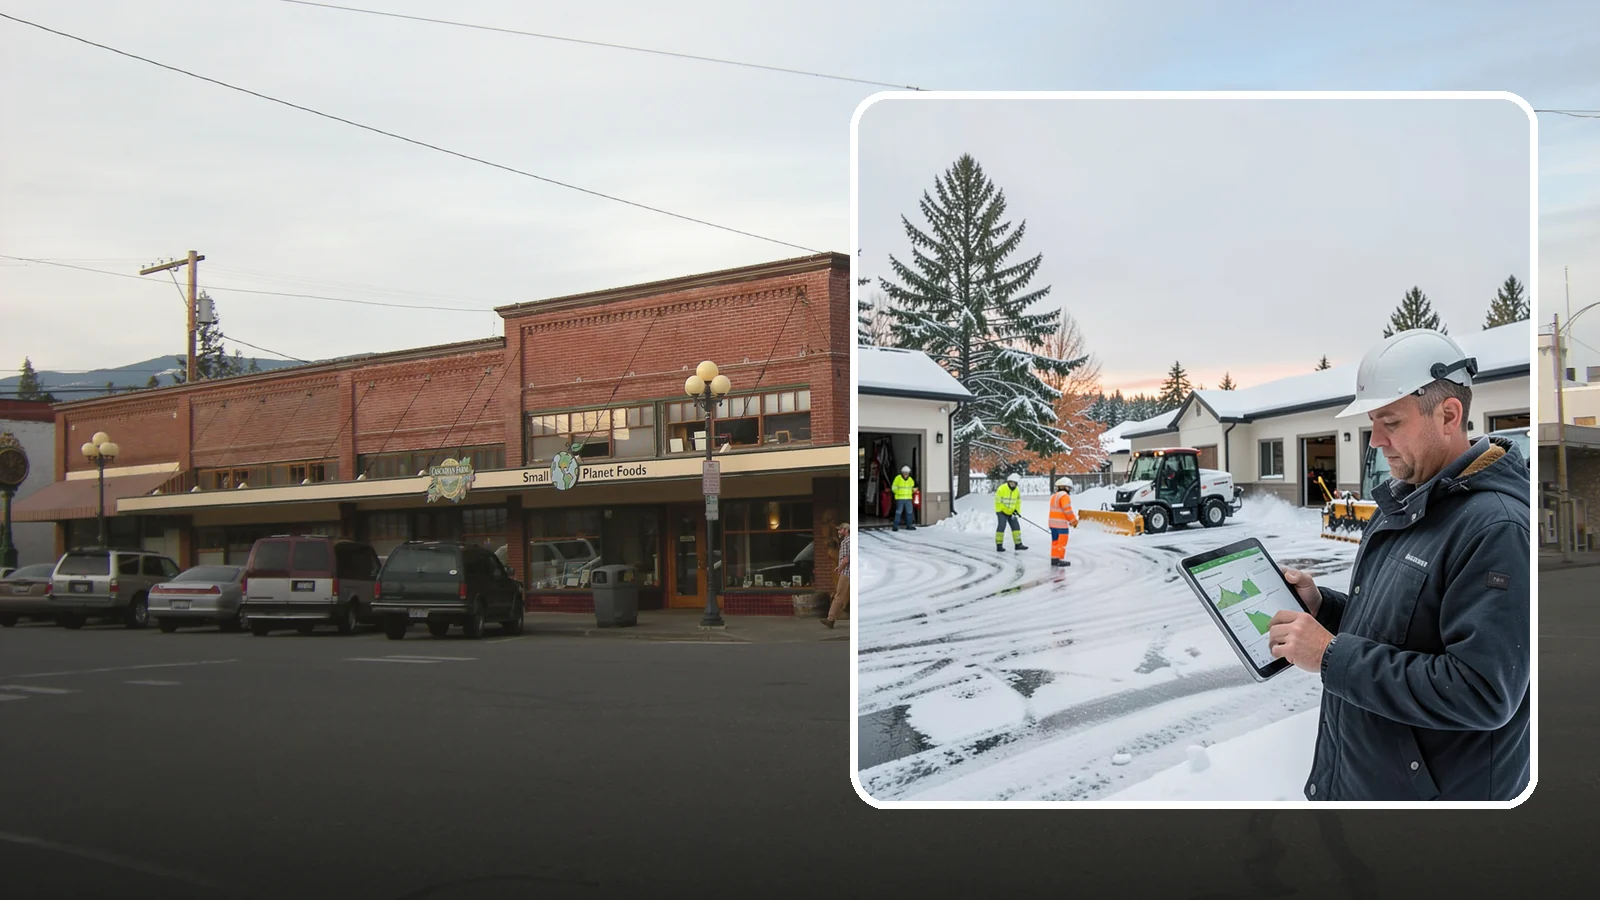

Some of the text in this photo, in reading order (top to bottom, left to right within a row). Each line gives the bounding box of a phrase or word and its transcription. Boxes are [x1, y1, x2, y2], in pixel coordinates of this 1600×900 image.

[432, 466, 456, 476] CASCADIAN
[523, 464, 647, 483] Small Planet Foods
